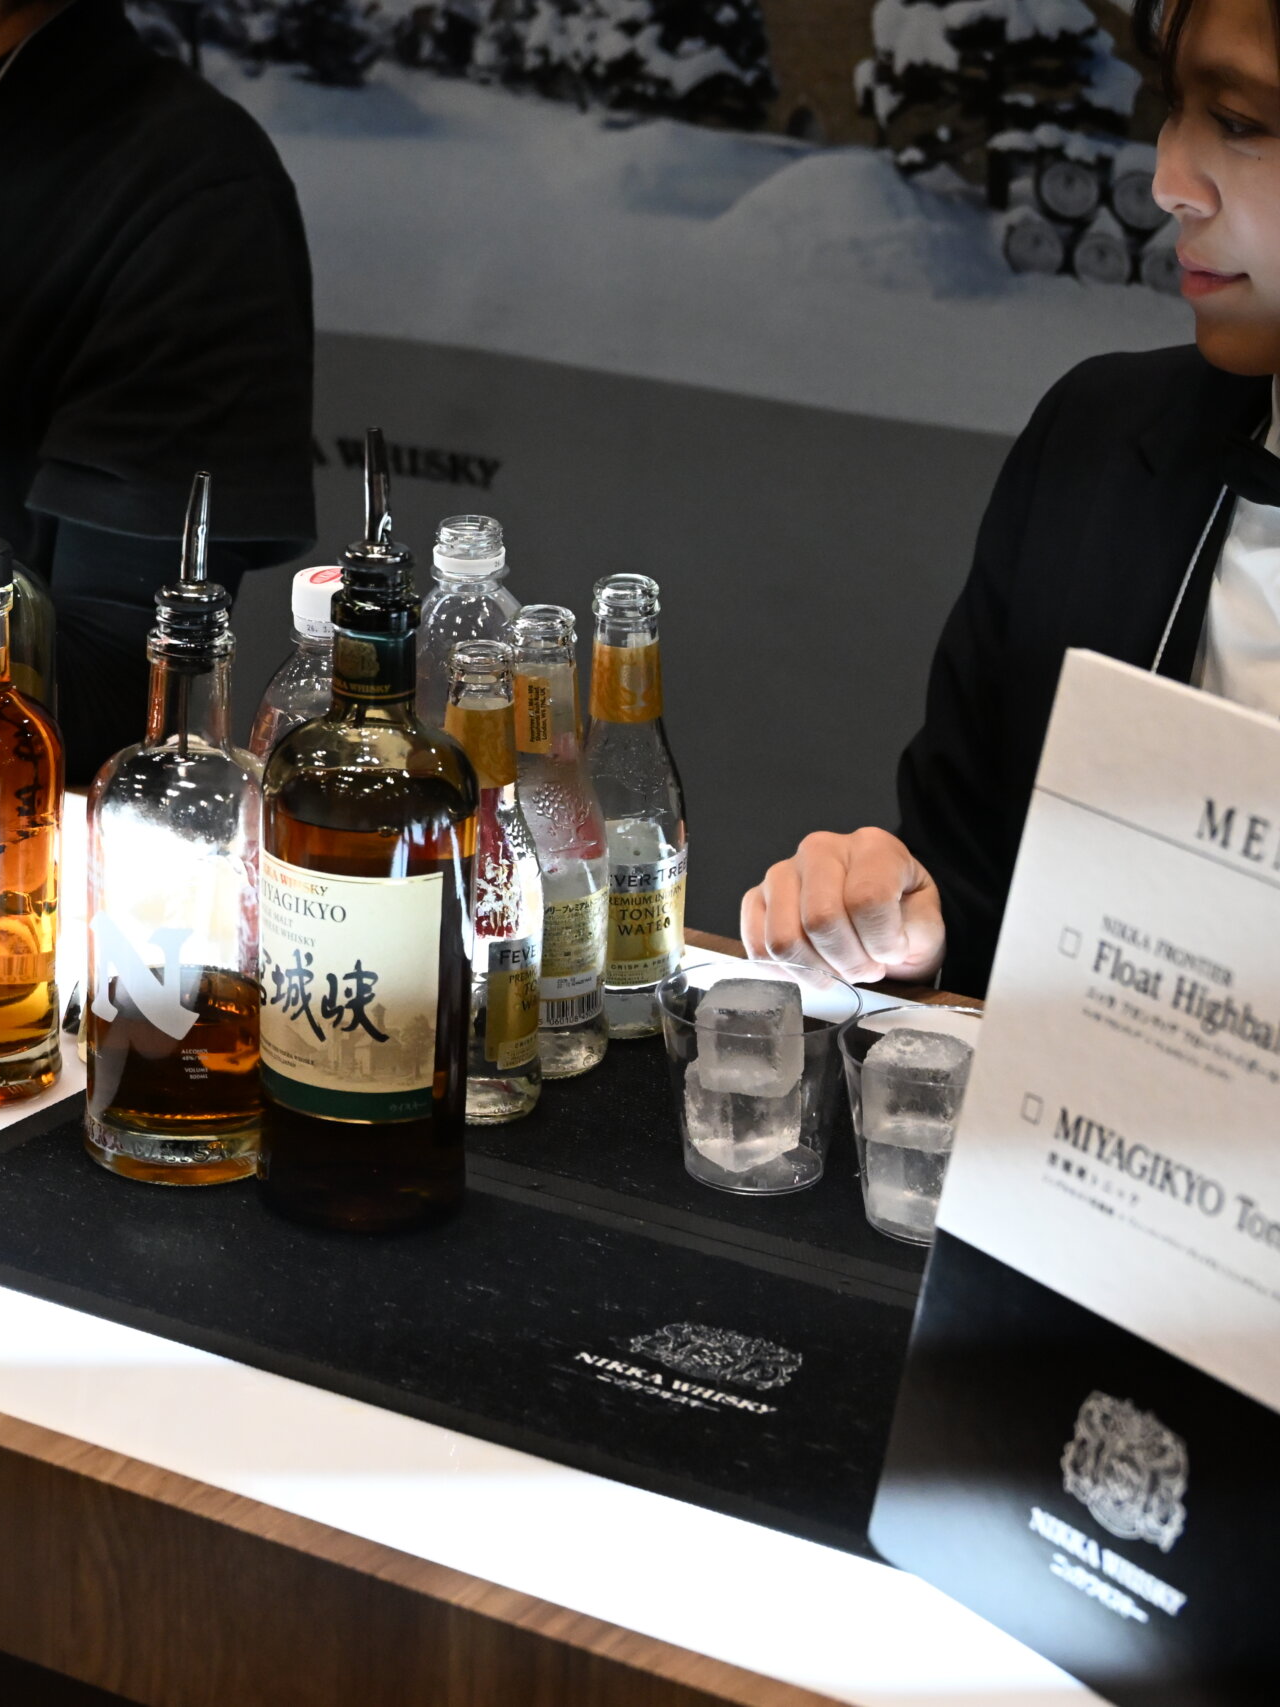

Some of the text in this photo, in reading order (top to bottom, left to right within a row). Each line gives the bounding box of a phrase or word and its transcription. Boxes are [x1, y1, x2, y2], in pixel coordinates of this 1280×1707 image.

[1195, 796, 1280, 870] ME
[609, 857, 687, 888] VER-TREE
[262, 880, 347, 923] IYAGIKYO
[609, 894, 652, 907] REMIUM
[619, 902, 671, 921] TONIC
[281, 929, 316, 949] WHISKY
[618, 916, 671, 936] WATE
[90, 910, 200, 1041] N
[500, 944, 537, 965] FEVE
[1092, 938, 1164, 1000] Float
[1154, 937, 1235, 988] FRONTIER
[1053, 1106, 1226, 1218] MIYAGIKYO
[575, 1352, 778, 1414] NIKKA WHISKY
